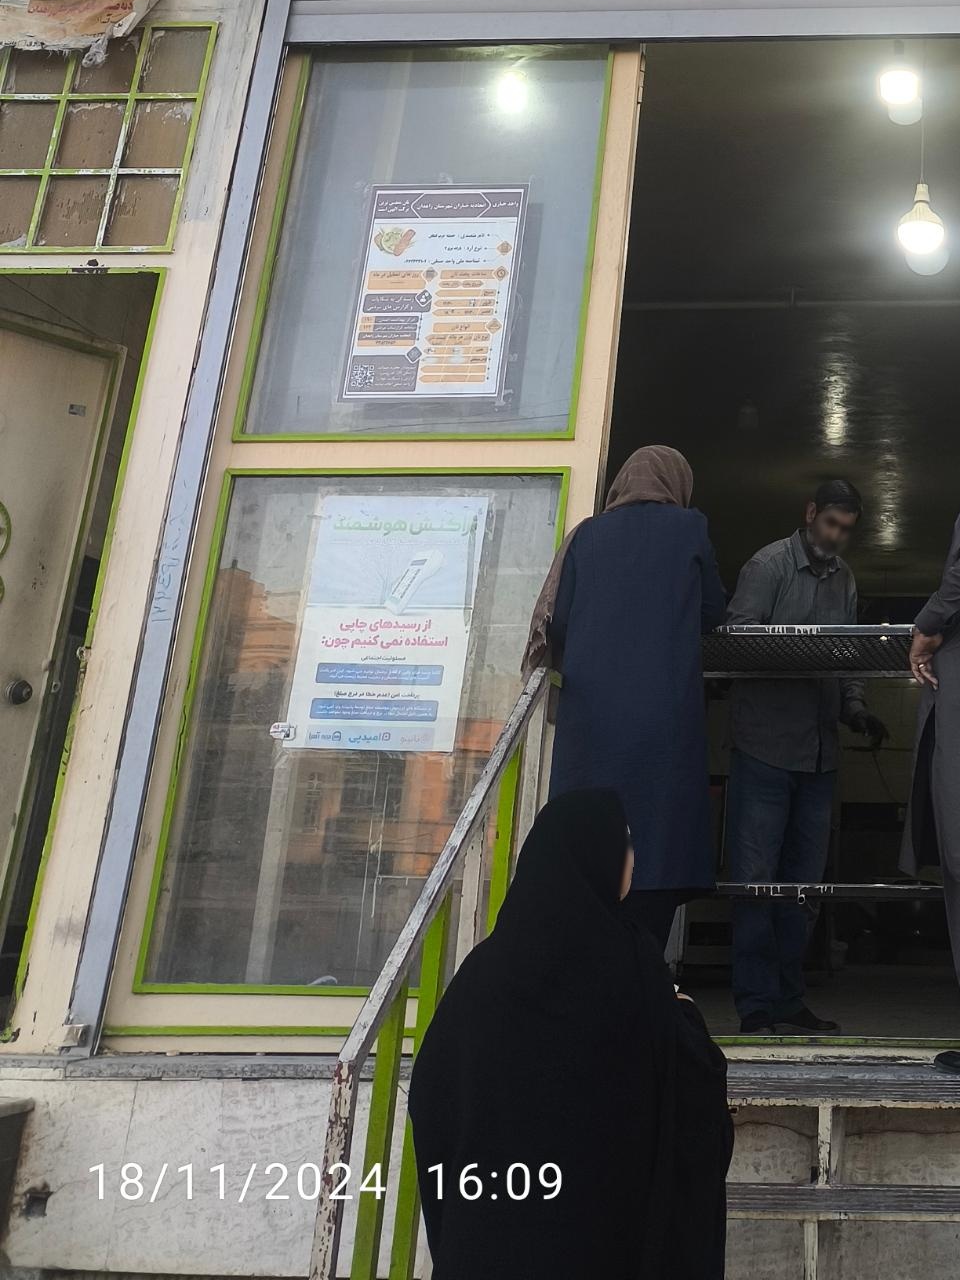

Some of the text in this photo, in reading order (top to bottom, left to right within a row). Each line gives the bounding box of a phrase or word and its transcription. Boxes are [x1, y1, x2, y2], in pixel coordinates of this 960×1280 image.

[333, 509, 408, 537] هوشمند
[340, 619, 432, 634] از رسیدهای چاپی
[321, 635, 449, 650] استفاده نمی کنیم چون:
